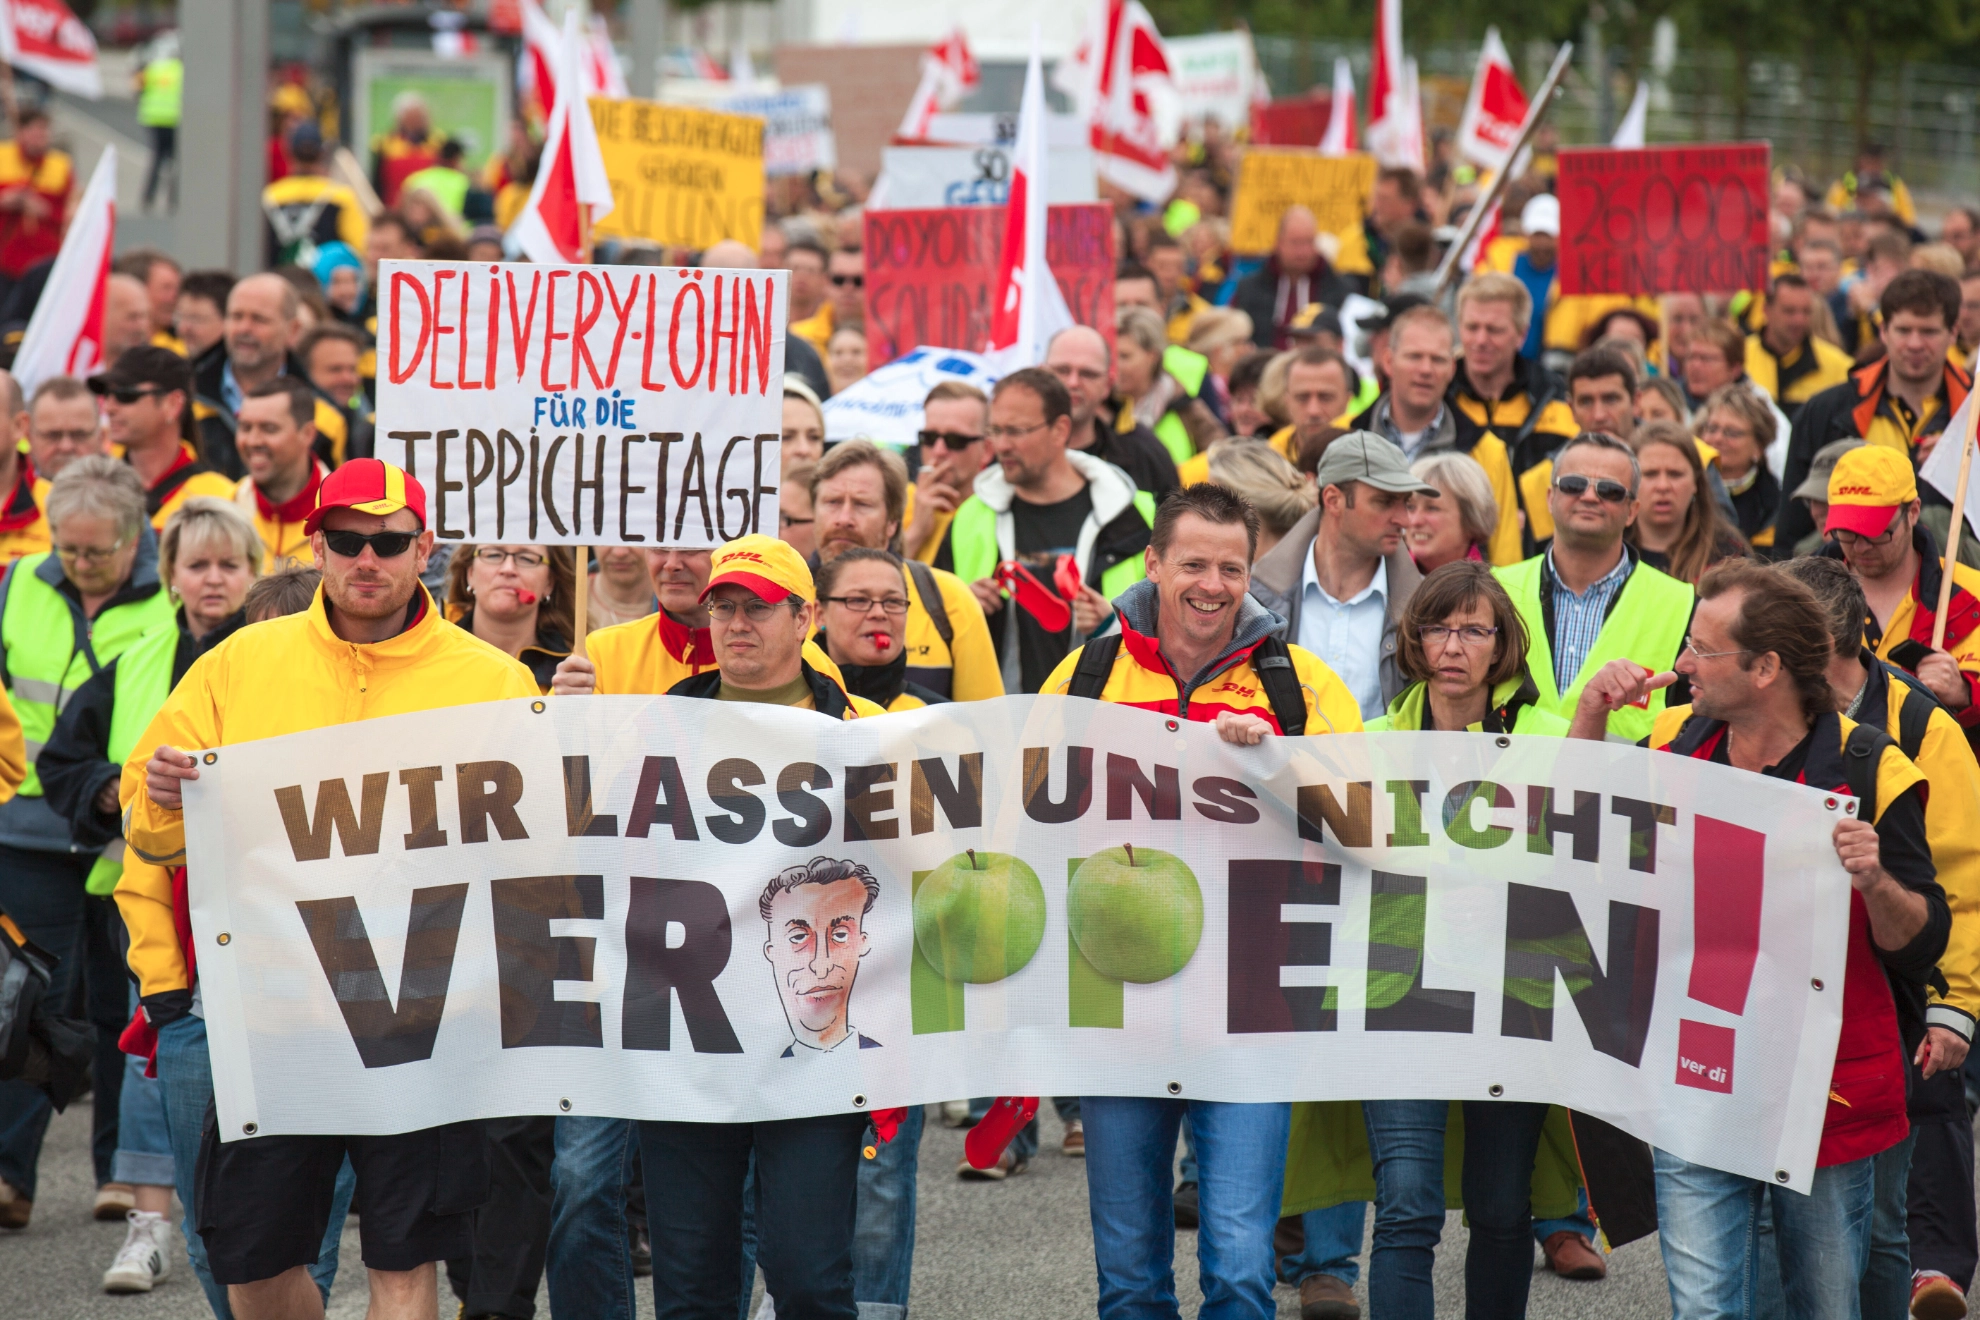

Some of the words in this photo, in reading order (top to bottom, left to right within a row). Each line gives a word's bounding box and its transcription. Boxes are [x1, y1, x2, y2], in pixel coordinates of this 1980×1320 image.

[534, 392, 586, 429] FÜR
[720, 551, 765, 564] DHL
[274, 760, 530, 862] WIR
[562, 751, 984, 848] LASSEN
[1022, 747, 1261, 824] UNS
[1297, 780, 1677, 874] NICHT
